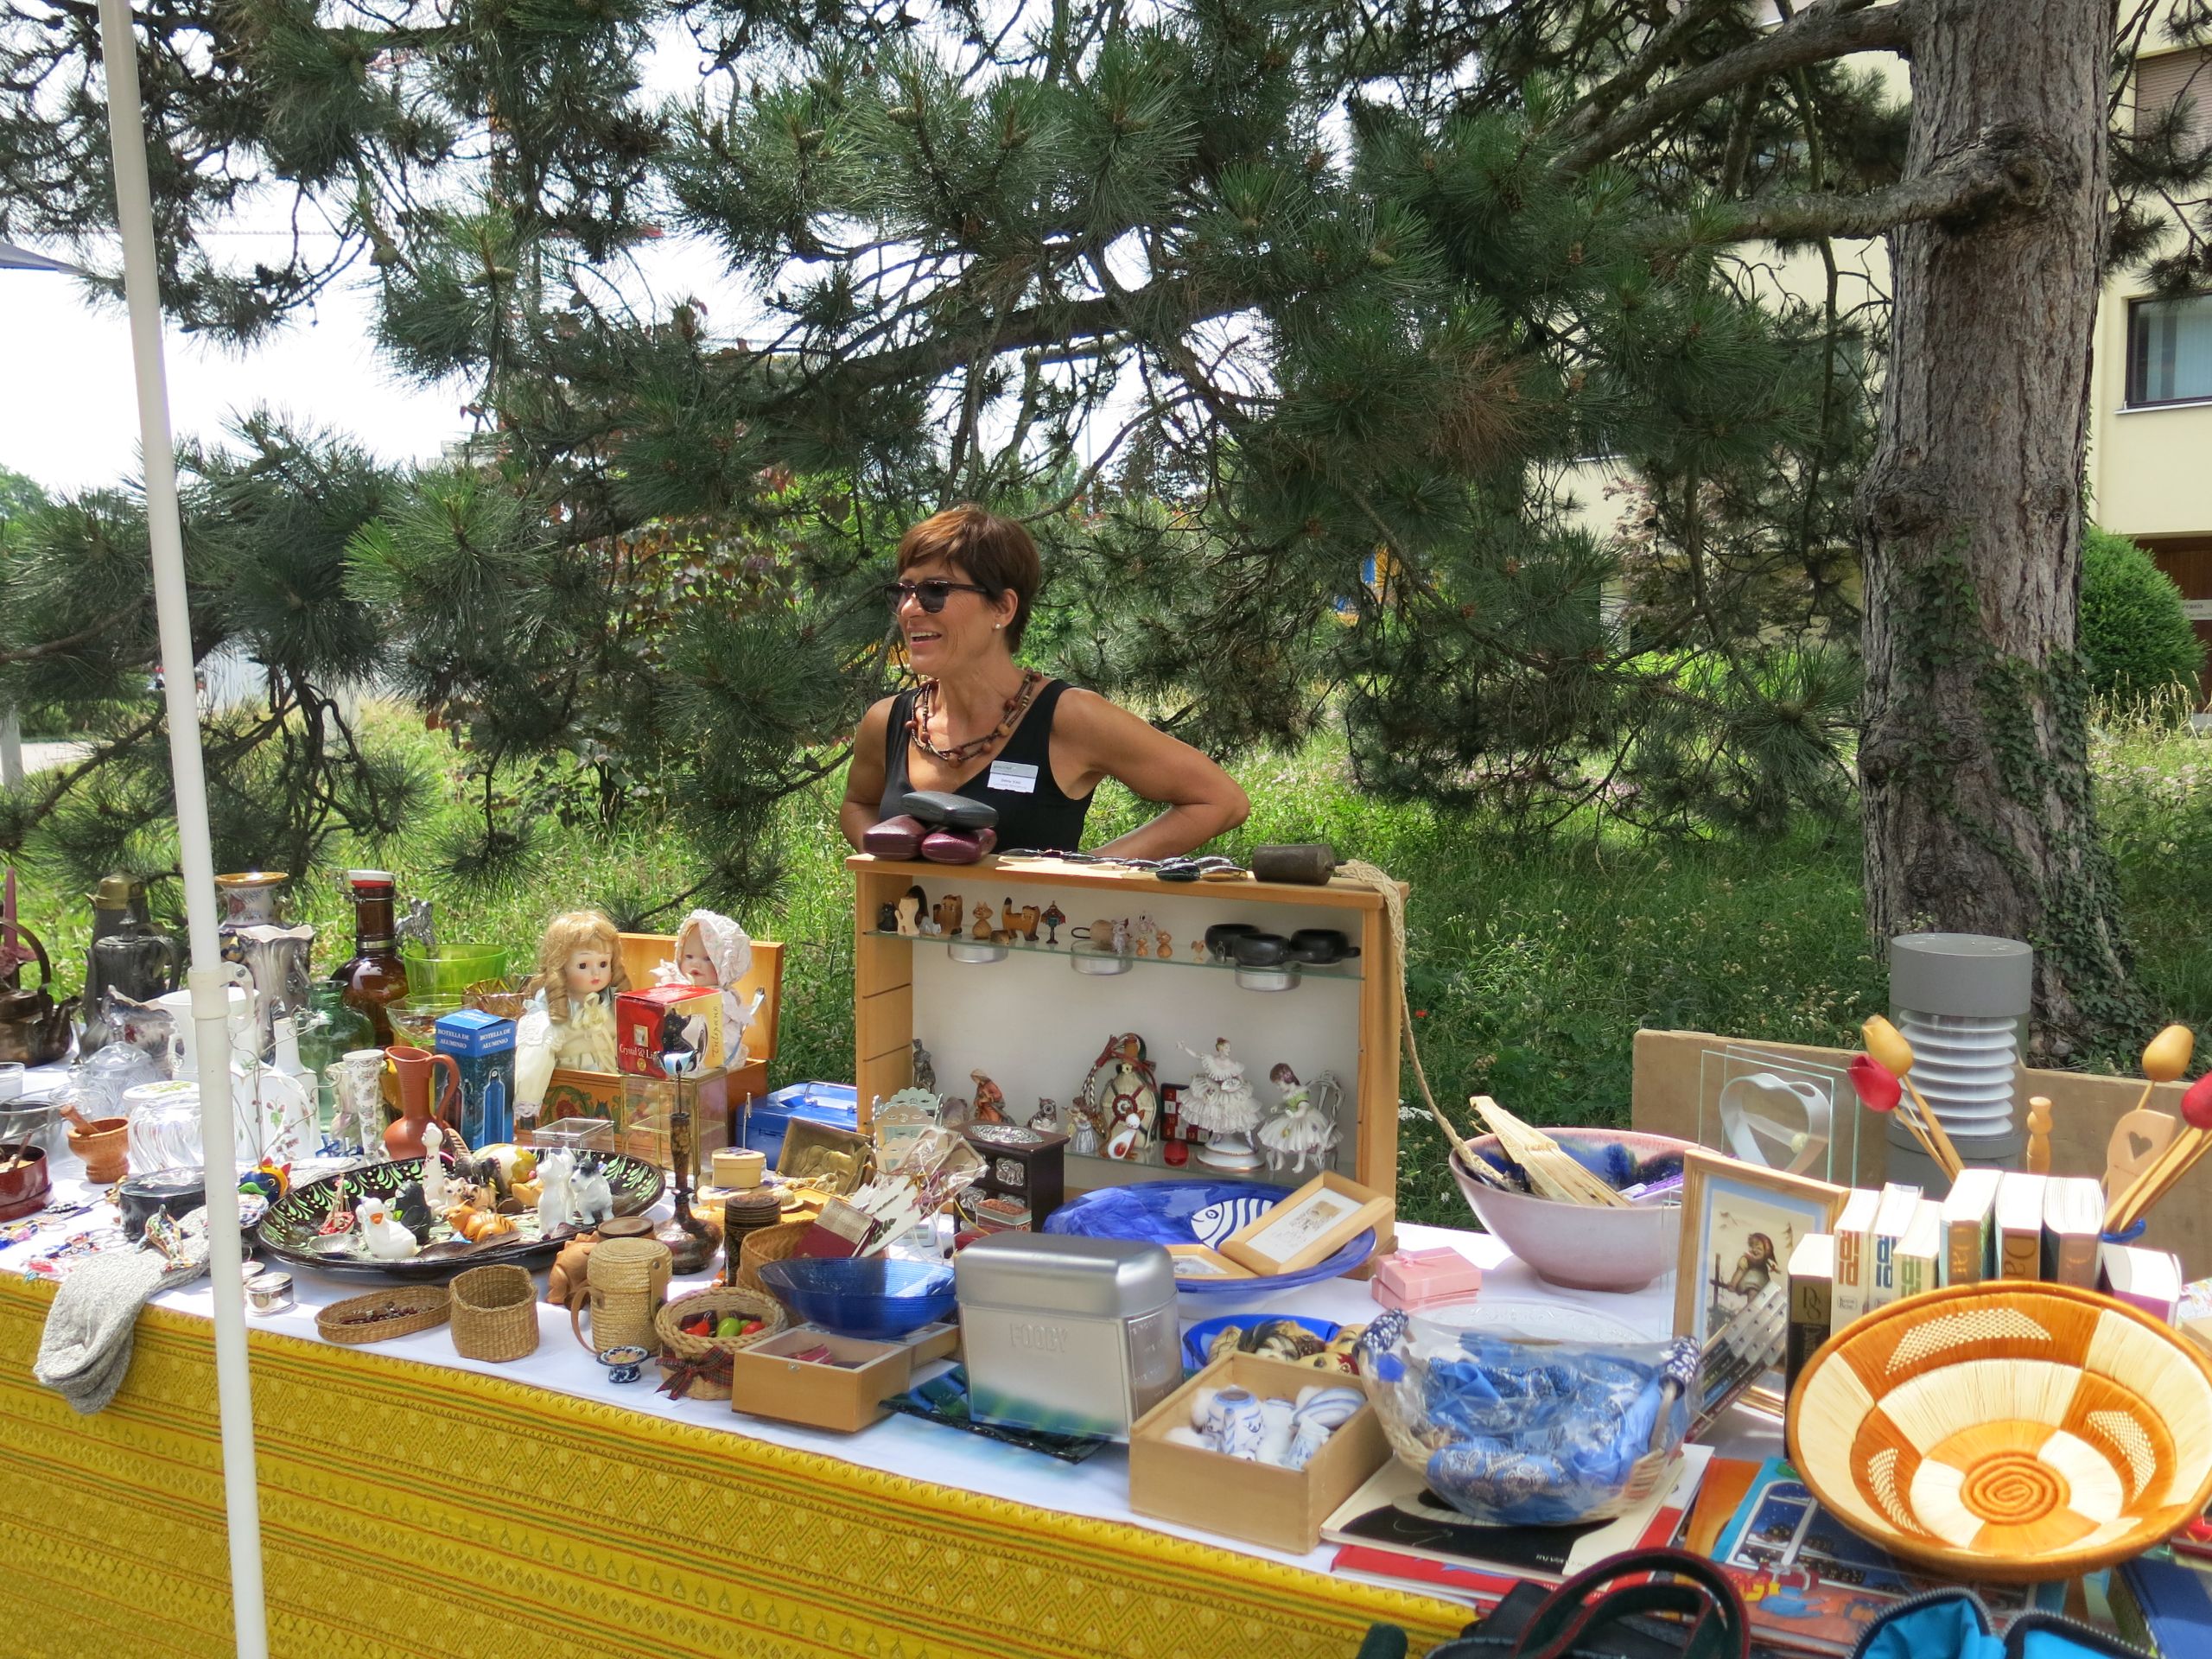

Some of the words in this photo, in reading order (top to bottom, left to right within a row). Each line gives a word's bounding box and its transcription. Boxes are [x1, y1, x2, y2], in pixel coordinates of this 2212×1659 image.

[437, 1028, 461, 1039] BOTELLA
[480, 1031, 503, 1041] BOTELLA
[440, 1039, 467, 1049] ALUMINIO
[482, 1038, 509, 1049] ALUMINIO
